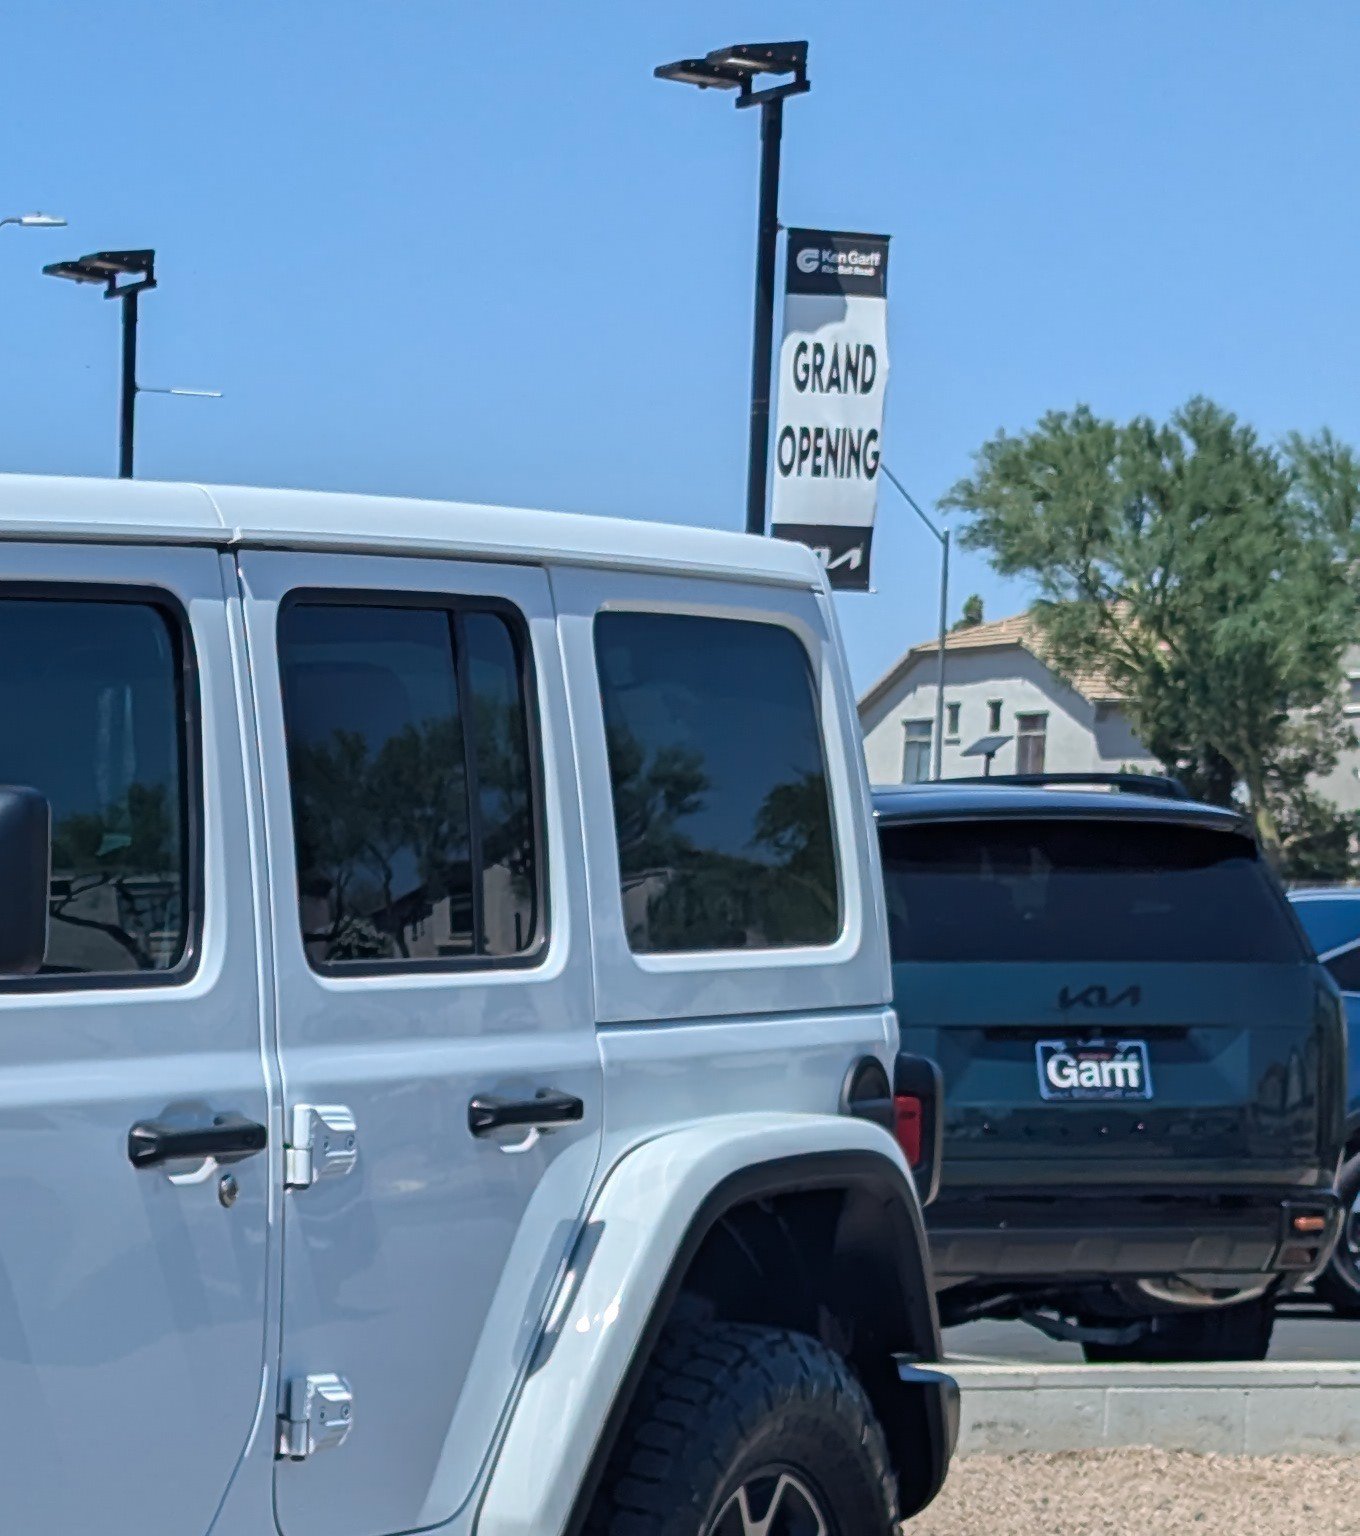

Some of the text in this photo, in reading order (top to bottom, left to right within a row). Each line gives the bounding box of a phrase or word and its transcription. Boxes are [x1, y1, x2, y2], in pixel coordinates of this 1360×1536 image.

[792, 341, 877, 395] GRAND
[777, 425, 880, 481] OPENING
[1057, 984, 1142, 1010] KIA
[1046, 1052, 1141, 1089] Garff
